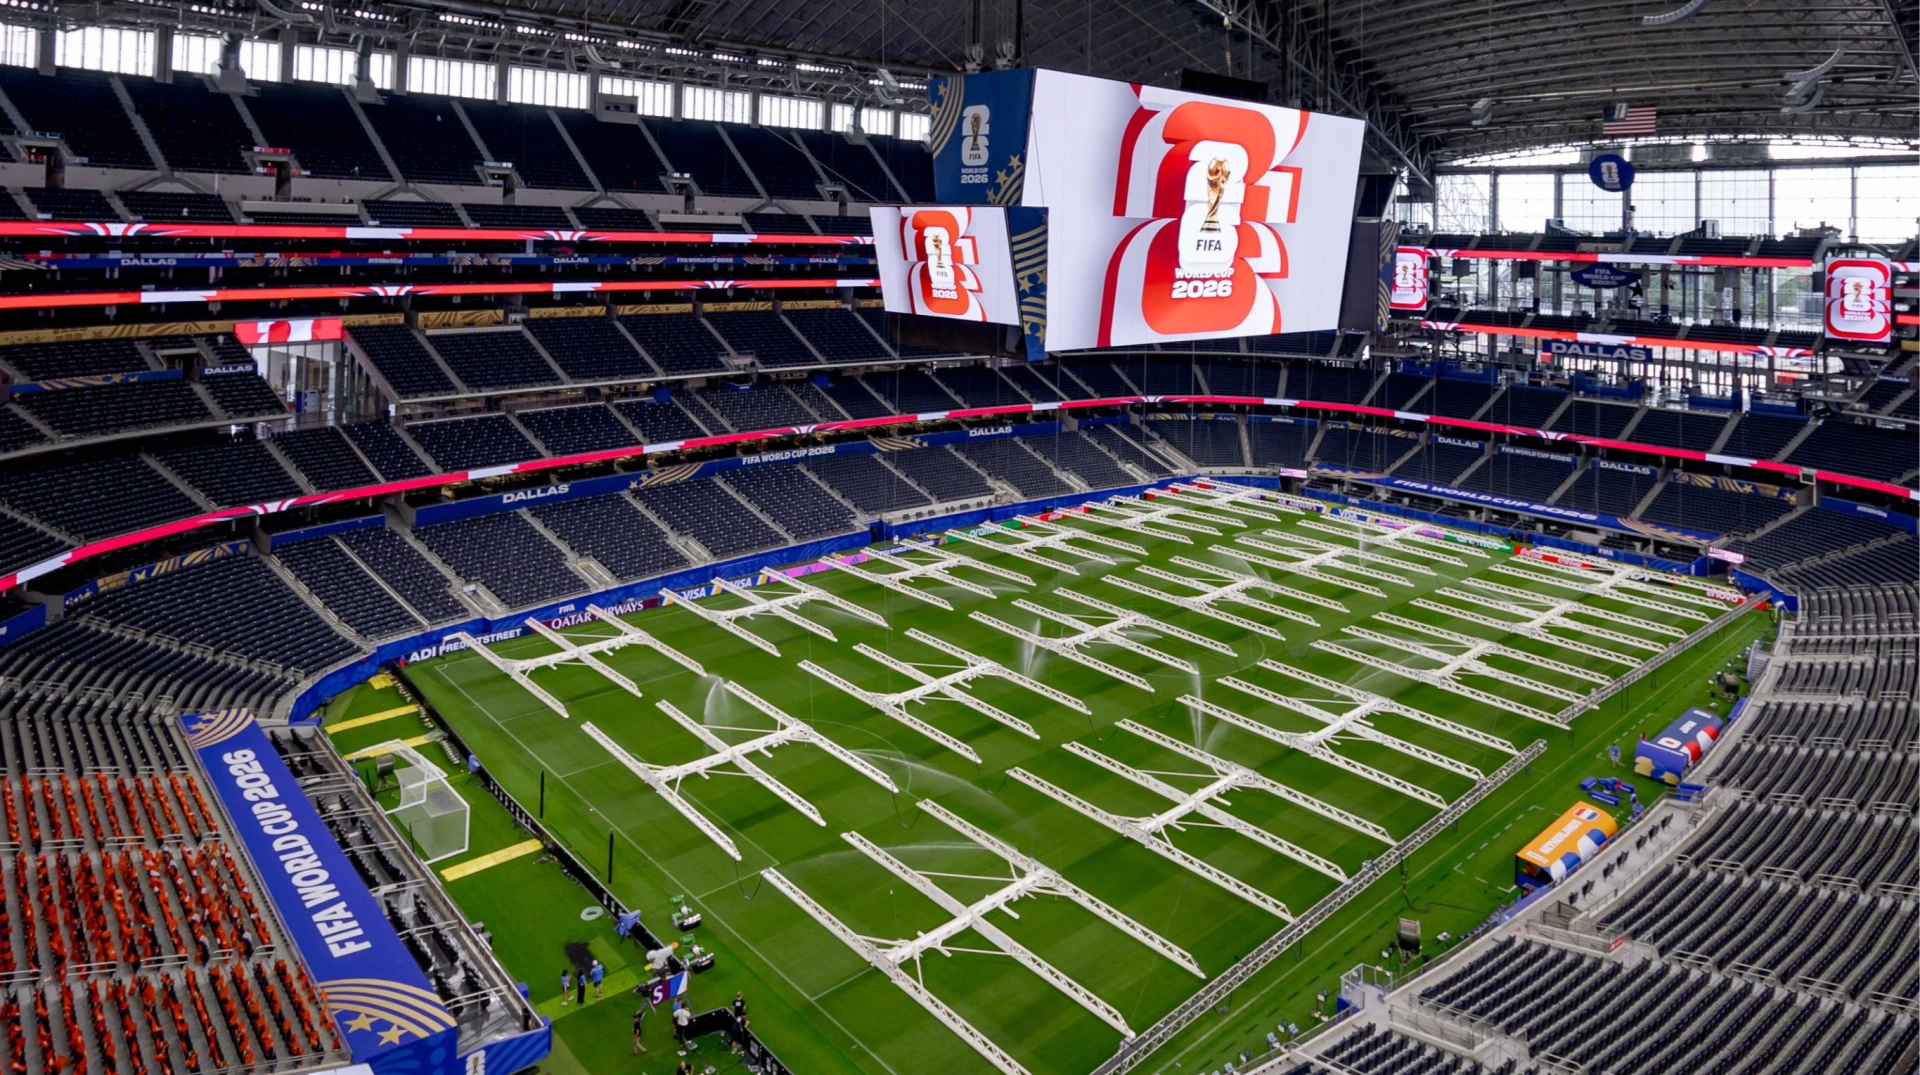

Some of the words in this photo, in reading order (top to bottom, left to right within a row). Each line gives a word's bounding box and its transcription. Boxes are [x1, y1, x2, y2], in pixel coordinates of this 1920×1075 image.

[960, 174, 989, 184] 2026
[1196, 239, 1222, 251] FIFA
[120, 257, 177, 265] DALLAS
[1174, 267, 1213, 279] WORLD
[1214, 267, 1235, 278] CUP
[932, 289, 958, 300] 2026
[1171, 279, 1233, 299] 2026
[1551, 342, 1647, 361] DALLAS
[204, 364, 253, 375] DALLAS
[969, 426, 1012, 437] DALLAS
[1437, 436, 1479, 448] DALLAS
[742, 457, 760, 465] FIFA
[761, 451, 790, 462] WORLD
[791, 449, 807, 458] CUP
[808, 445, 835, 456] 2026
[1501, 446, 1514, 454] FIFA
[1515, 448, 1537, 457] WORLD
[1537, 451, 1550, 459] CUP
[1550, 454, 1572, 462] 2026
[1600, 461, 1651, 475] DALLAS
[502, 484, 570, 504] DALLAS
[1393, 479, 1429, 490] FIFA
[1431, 485, 1493, 501] WORLD
[1492, 497, 1530, 507] CUP
[1529, 503, 1599, 521] 2026
[1338, 508, 1358, 520] VISA
[1598, 548, 1614, 556] FIFA
[682, 587, 706, 600] VISA
[1706, 589, 1738, 602] enovo
[558, 603, 576, 614] FIFA
[551, 612, 592, 630] QATAR
[409, 646, 437, 662] ADI
[222, 749, 279, 802] 2026
[251, 801, 299, 835] CUP
[272, 833, 341, 908] WORLD
[311, 901, 372, 958] FIFA
